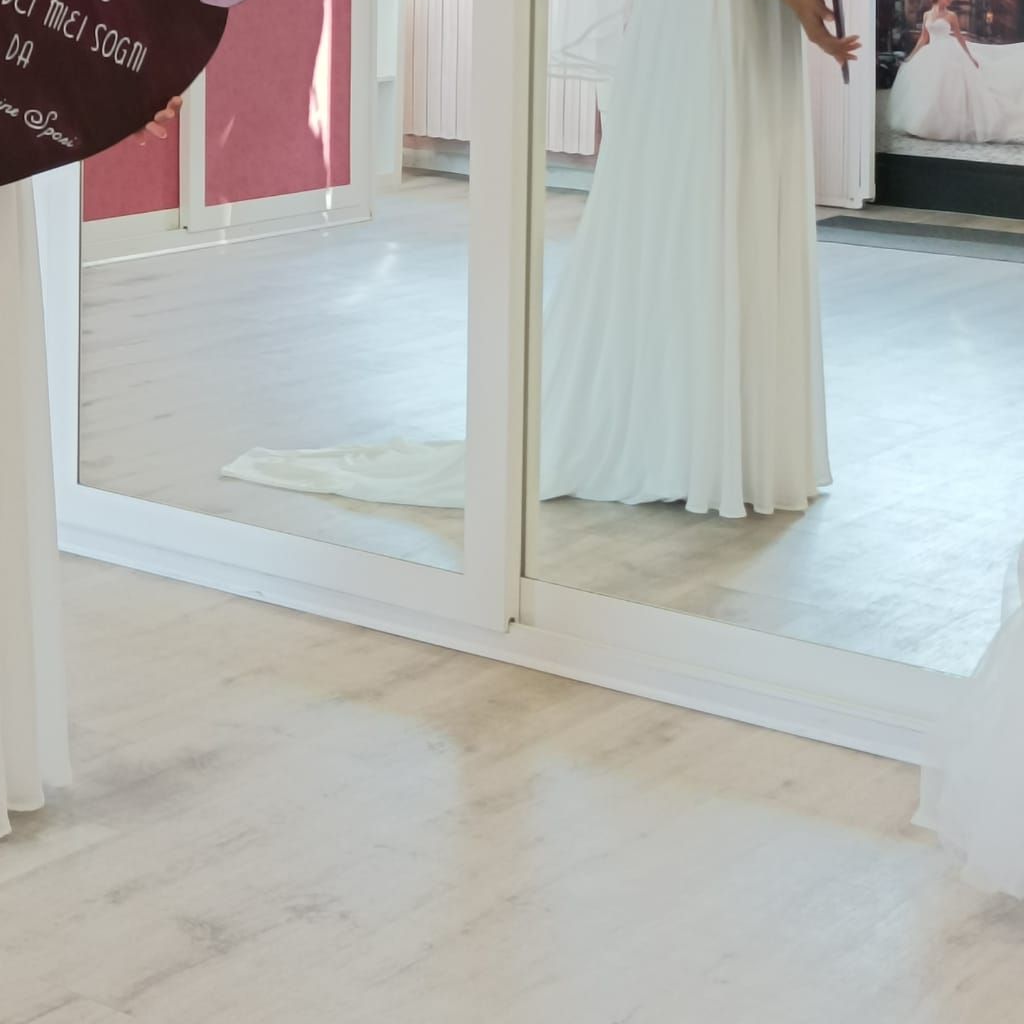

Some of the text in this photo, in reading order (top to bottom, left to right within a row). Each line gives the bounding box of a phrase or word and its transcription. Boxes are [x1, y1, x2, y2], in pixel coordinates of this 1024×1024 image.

[4, 33, 35, 69] DA
[90, 22, 148, 73] SOGNI
[23, 110, 79, 149] Sposi
